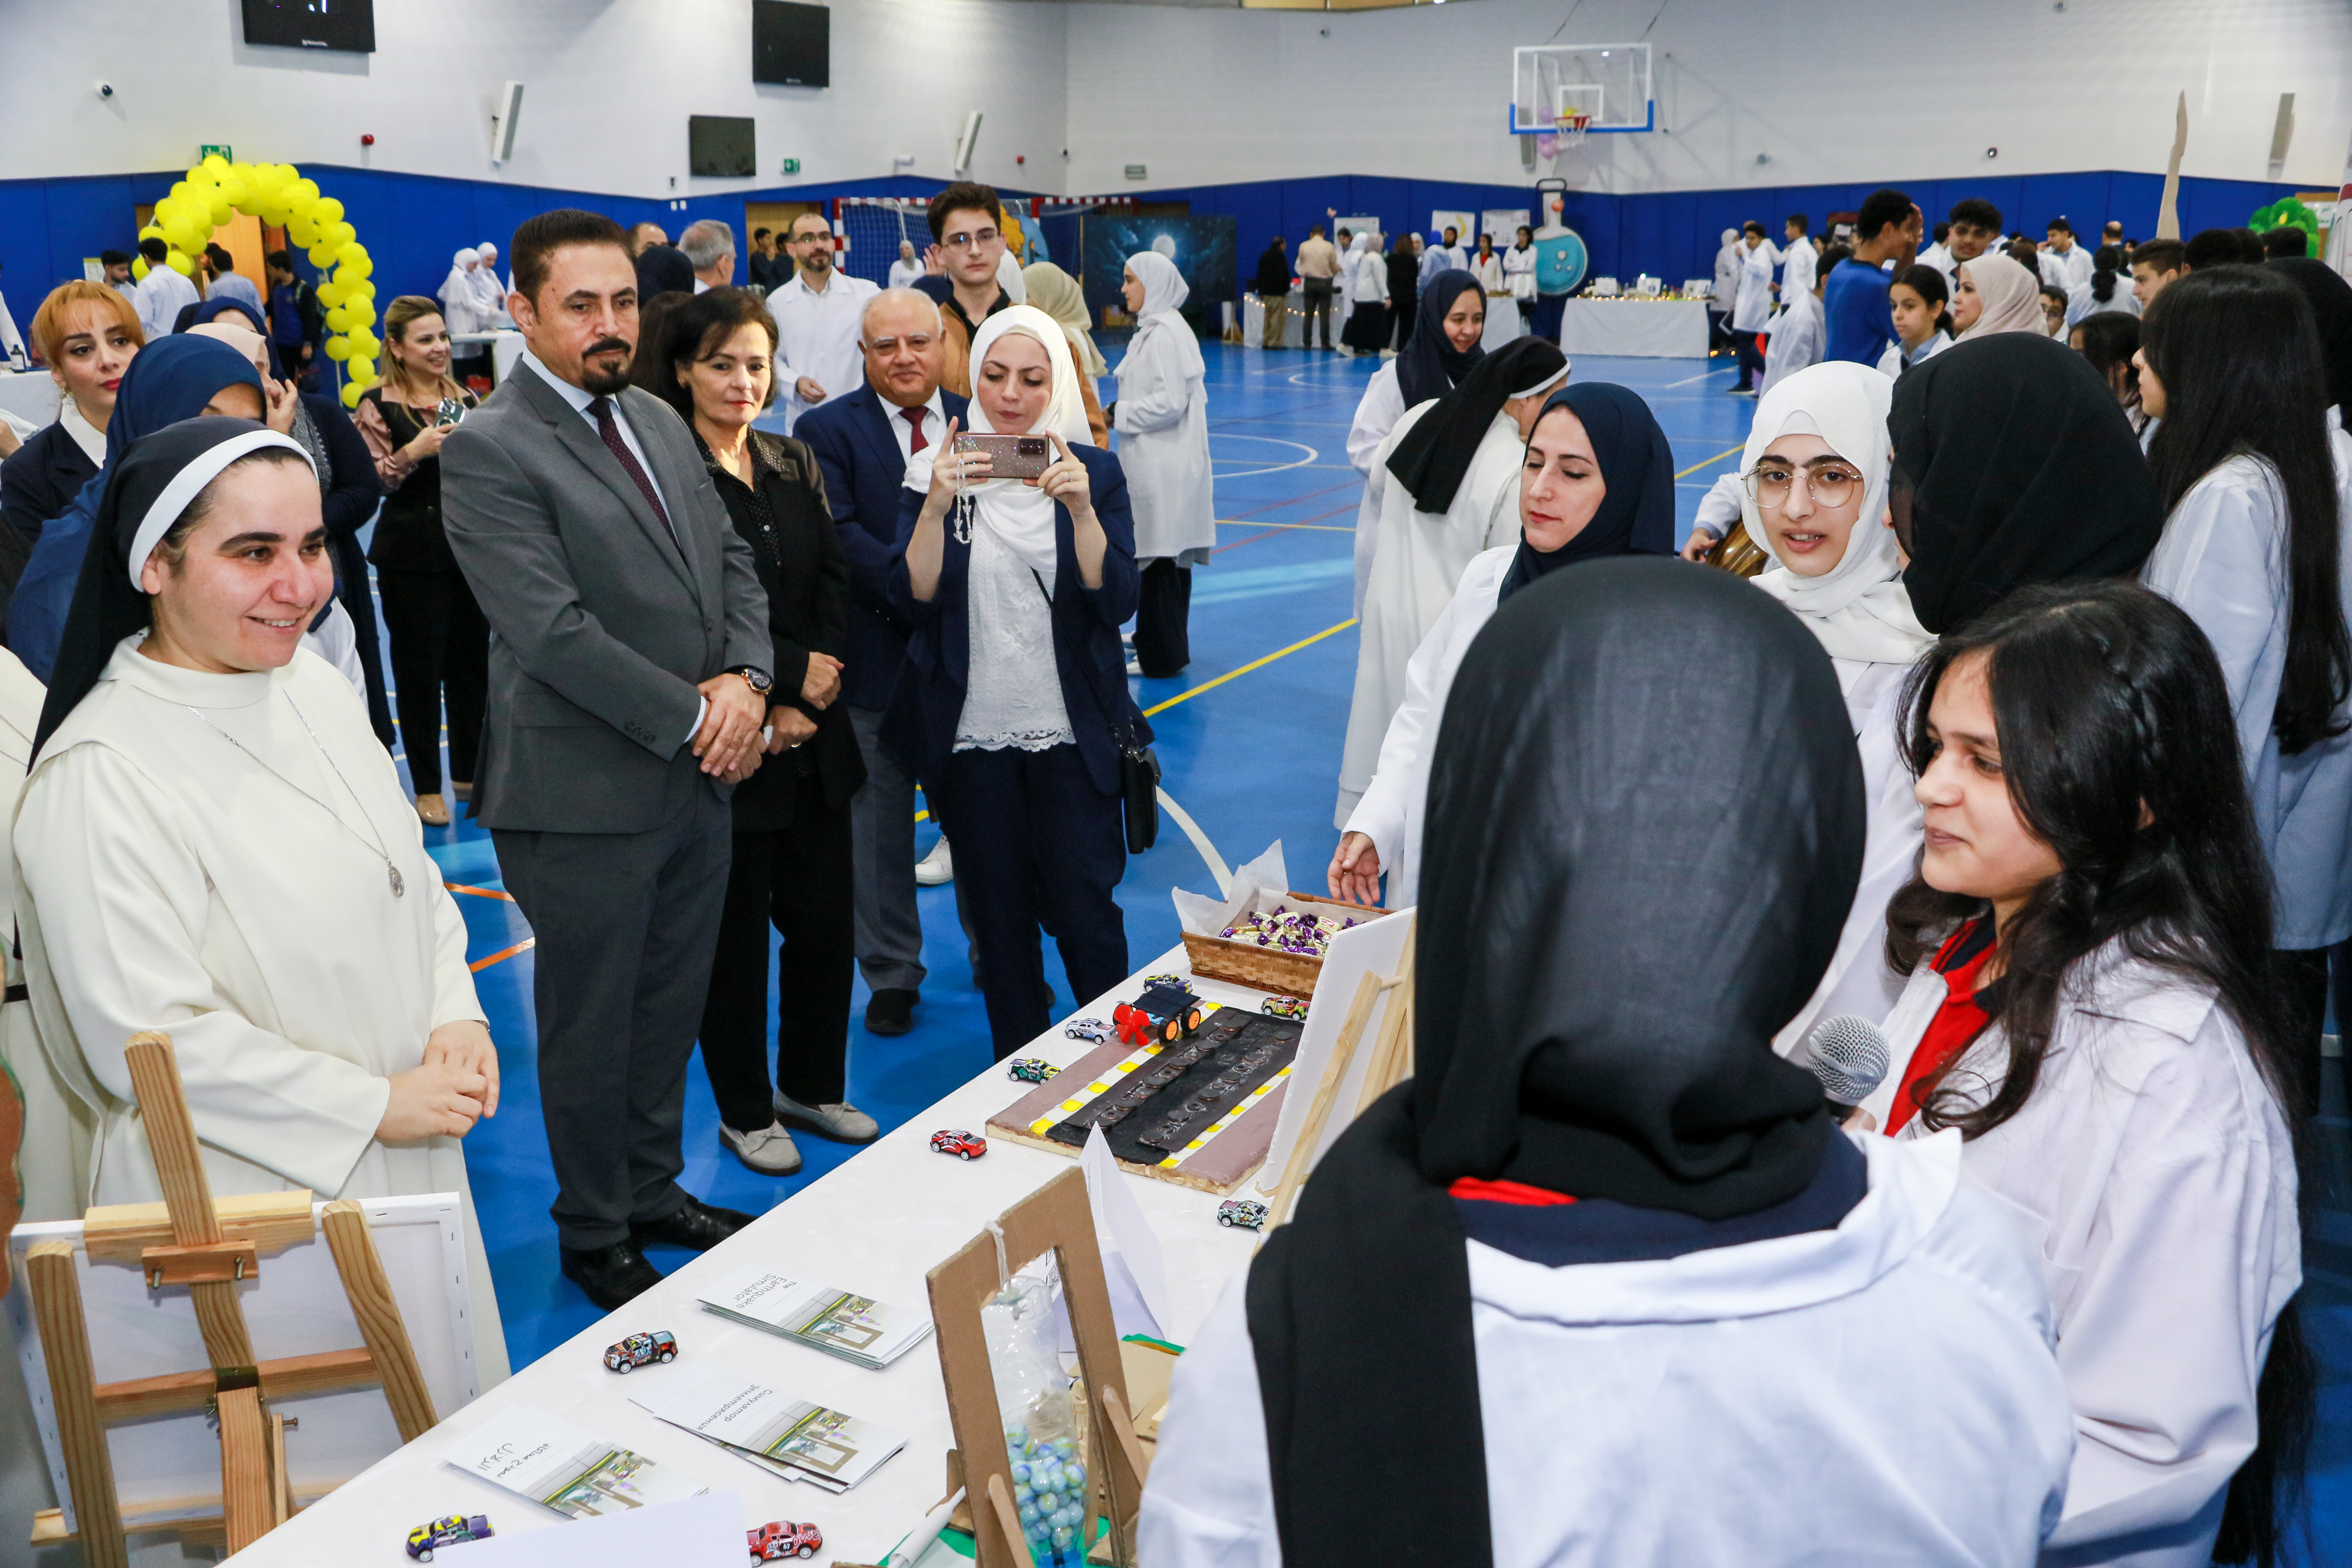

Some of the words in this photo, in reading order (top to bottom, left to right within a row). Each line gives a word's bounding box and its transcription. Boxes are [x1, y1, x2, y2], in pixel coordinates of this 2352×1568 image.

[734, 1274, 776, 1301] Simulator
[736, 1277, 787, 1308] Earthquake
[725, 1390, 773, 1422] Симулятор
[477, 1443, 514, 1470] الزلازل
[497, 1459, 523, 1478] نموذج
[523, 1443, 551, 1460] محاكاة
